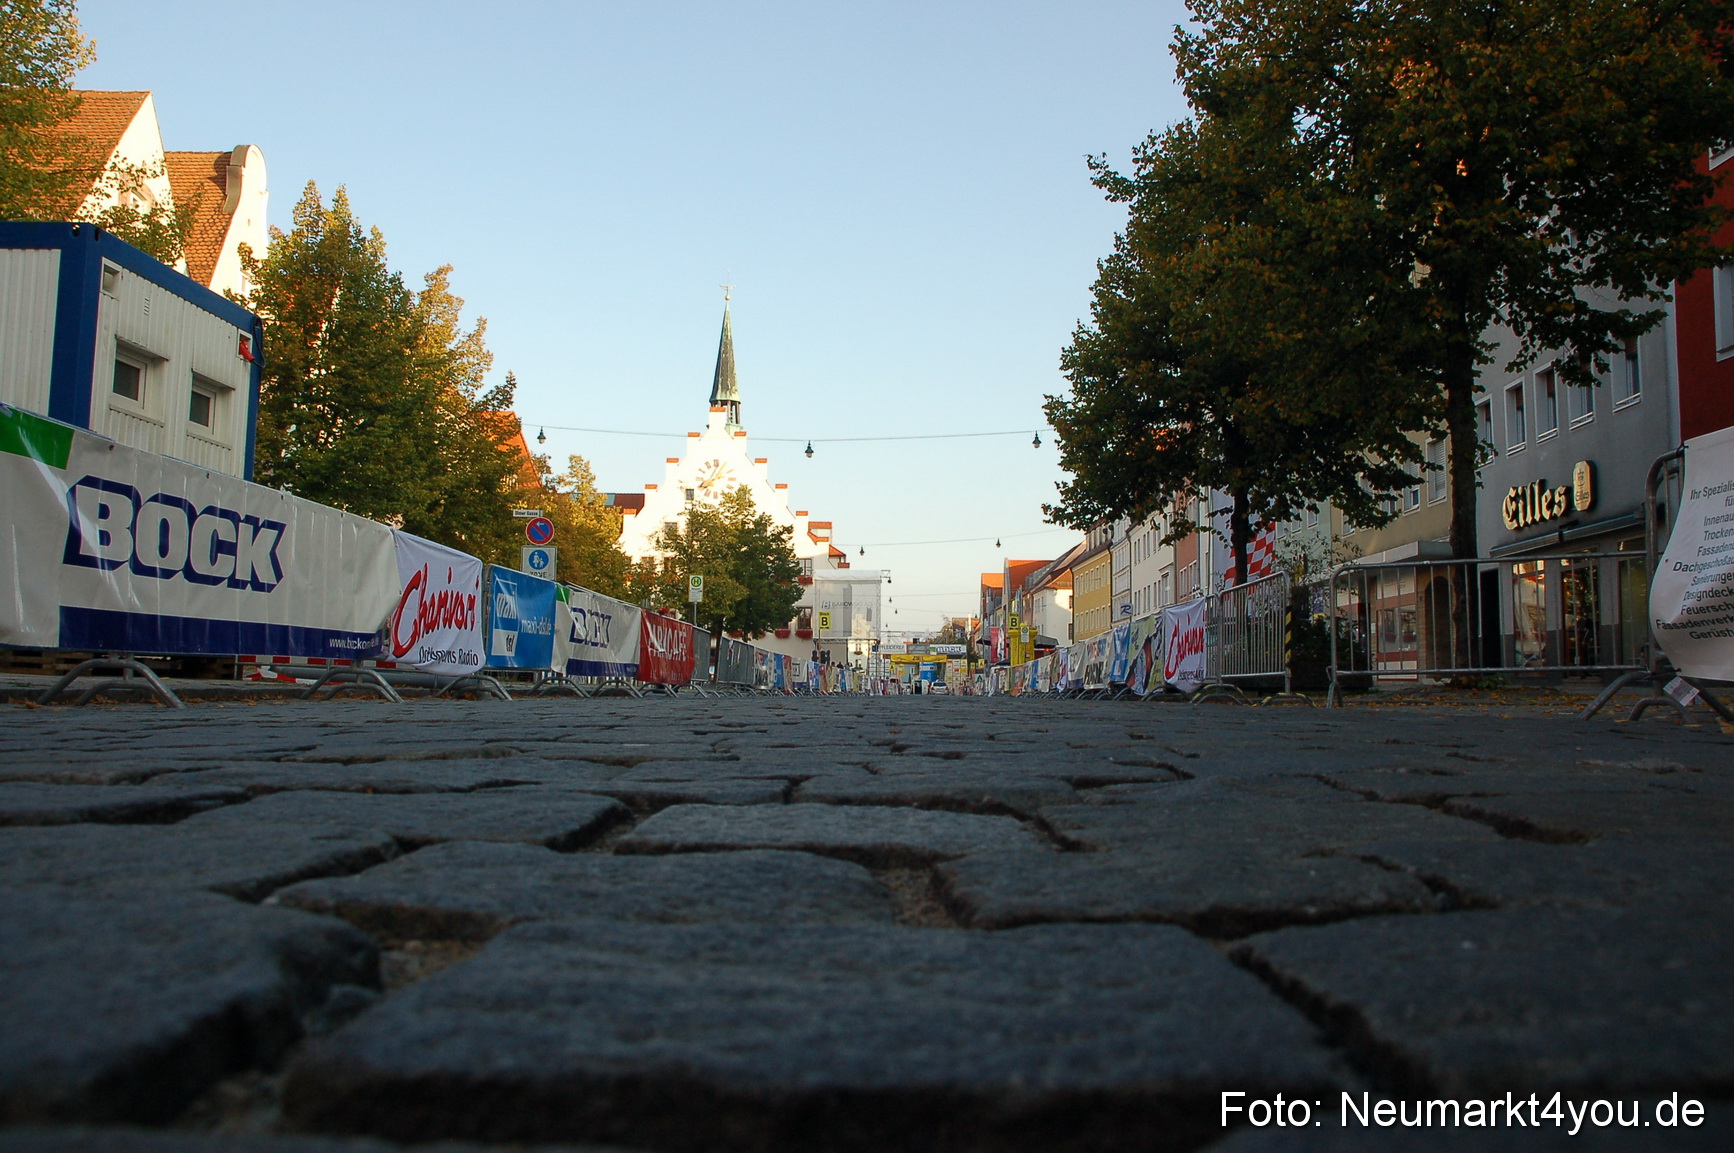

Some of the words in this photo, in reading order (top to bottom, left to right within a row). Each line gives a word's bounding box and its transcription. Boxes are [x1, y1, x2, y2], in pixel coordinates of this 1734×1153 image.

[1690, 489, 1701, 500] Ihr
[1503, 479, 1568, 530] Eilles
[62, 474, 287, 593] BOCK
[821, 616, 828, 626] B
[1011, 617, 1017, 627] B
[458, 648, 479, 666] Radio
